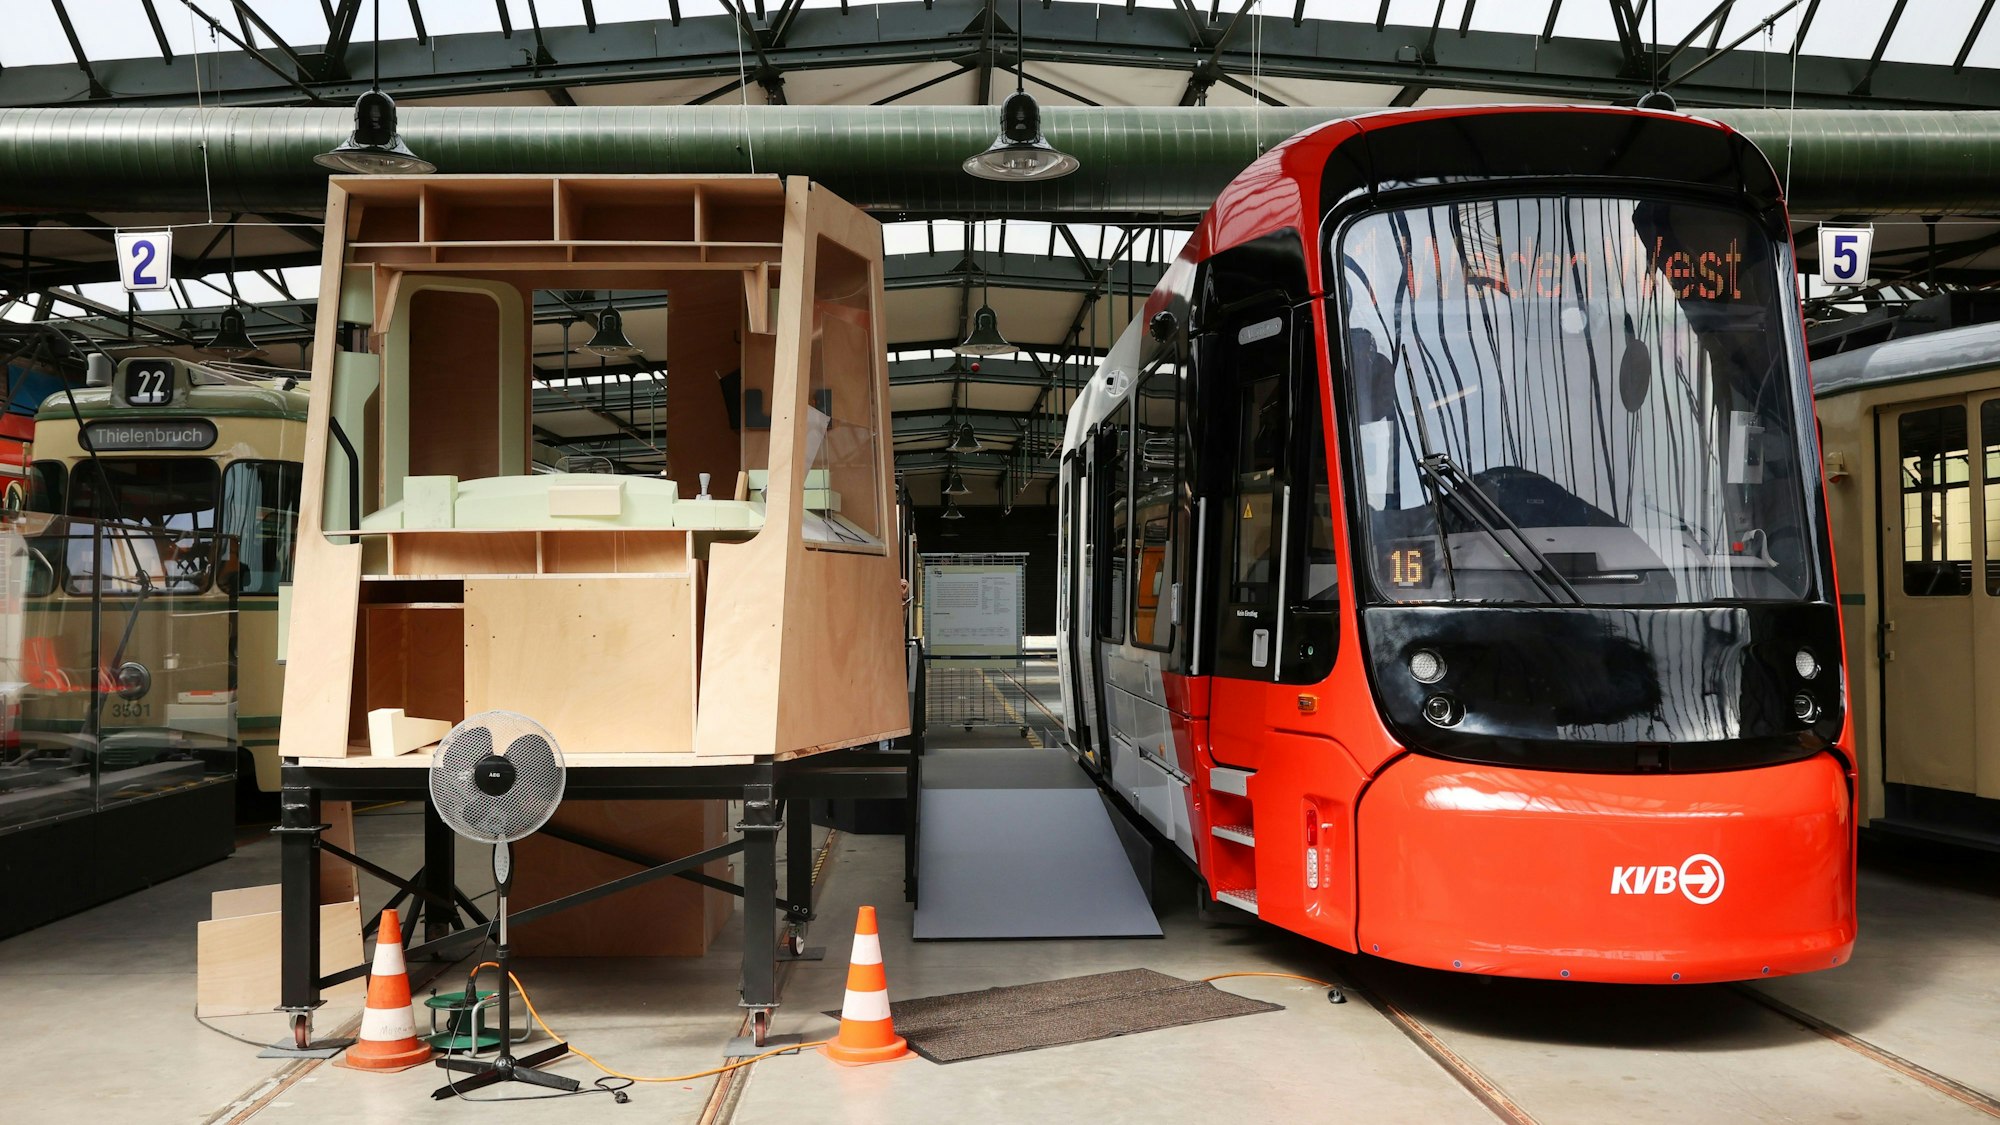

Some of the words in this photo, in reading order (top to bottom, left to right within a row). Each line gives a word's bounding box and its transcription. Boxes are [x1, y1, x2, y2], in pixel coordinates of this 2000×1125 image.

[132, 240, 157, 285] 2
[1605, 236, 1741, 300] West
[1834, 235, 1858, 279] 5
[138, 370, 166, 397] 22
[95, 428, 203, 443] Thielenbruch
[1391, 550, 1421, 582] 16
[112, 703, 151, 718] 3501
[1610, 866, 1678, 895] KVB
